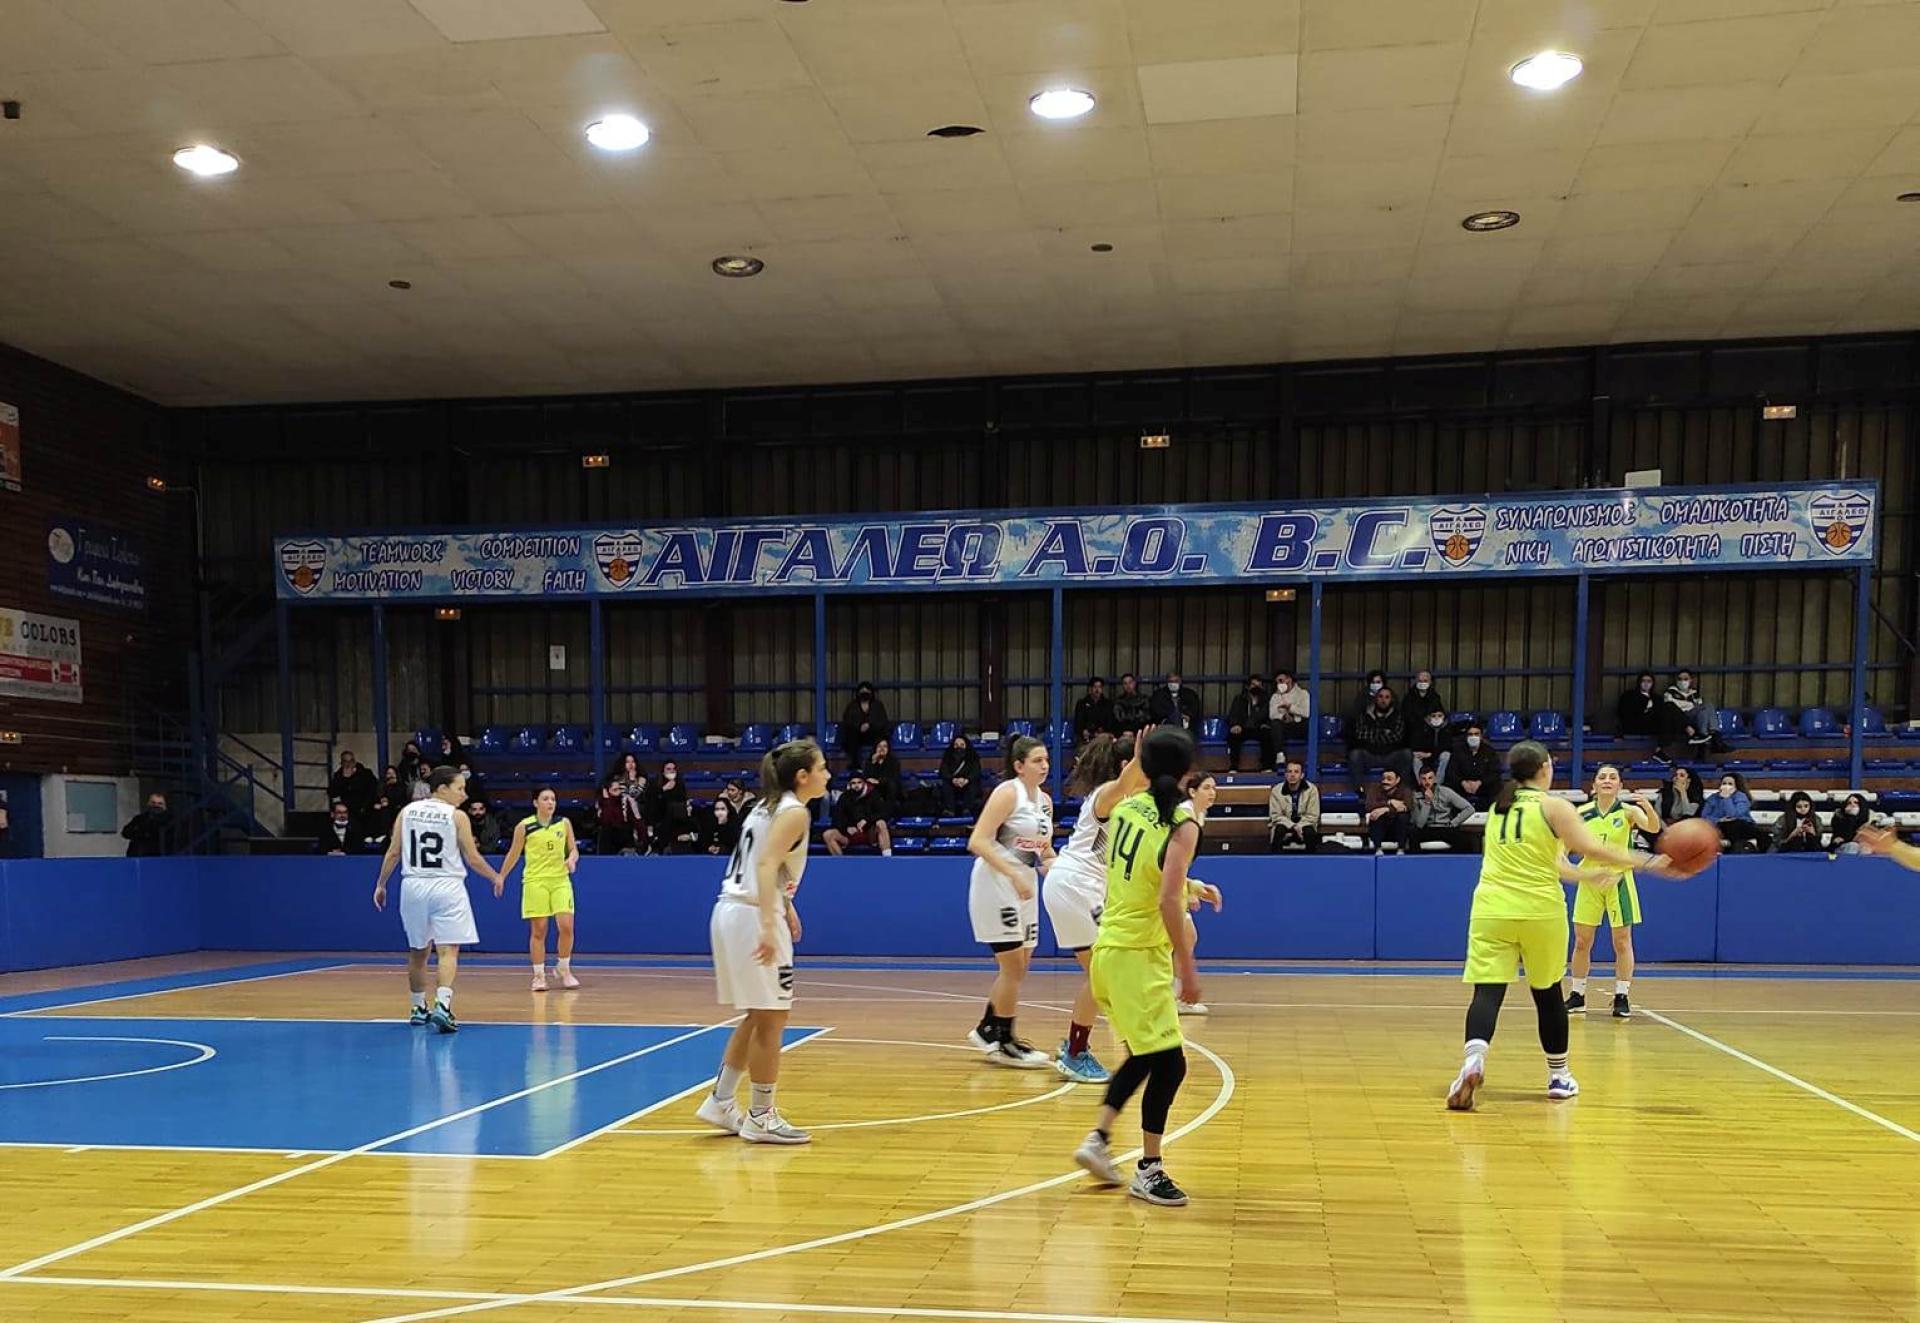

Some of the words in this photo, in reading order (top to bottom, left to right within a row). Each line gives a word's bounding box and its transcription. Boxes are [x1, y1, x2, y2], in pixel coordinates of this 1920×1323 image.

[1495, 500, 1637, 531] ΣΥΝΑΓΩΝΙΣΜΟΣ
[1658, 495, 1789, 525] ΟΜΑΔΙΚΟΤΗΤΑ
[360, 540, 443, 565] TEAMWORK
[480, 536, 580, 560] COMPETITION
[637, 523, 1004, 587] ΑΙΓΑΛΕΩ
[1243, 508, 1431, 573] B.C.
[1504, 541, 1551, 565] ΝΙΚΗ
[1571, 533, 1722, 563] ΑΓΩΝΙΣΤΙΚΟΤΗΤΑ
[1740, 532, 1796, 557] ΠΙΣΤΗ
[333, 569, 422, 591] MOTIVATION
[450, 568, 516, 590] VICTORY
[543, 569, 587, 591] FAITH
[20, 620, 77, 646] COLORS
[1498, 807, 1524, 844] 11
[410, 829, 444, 868] 12
[1110, 815, 1146, 881] 14
